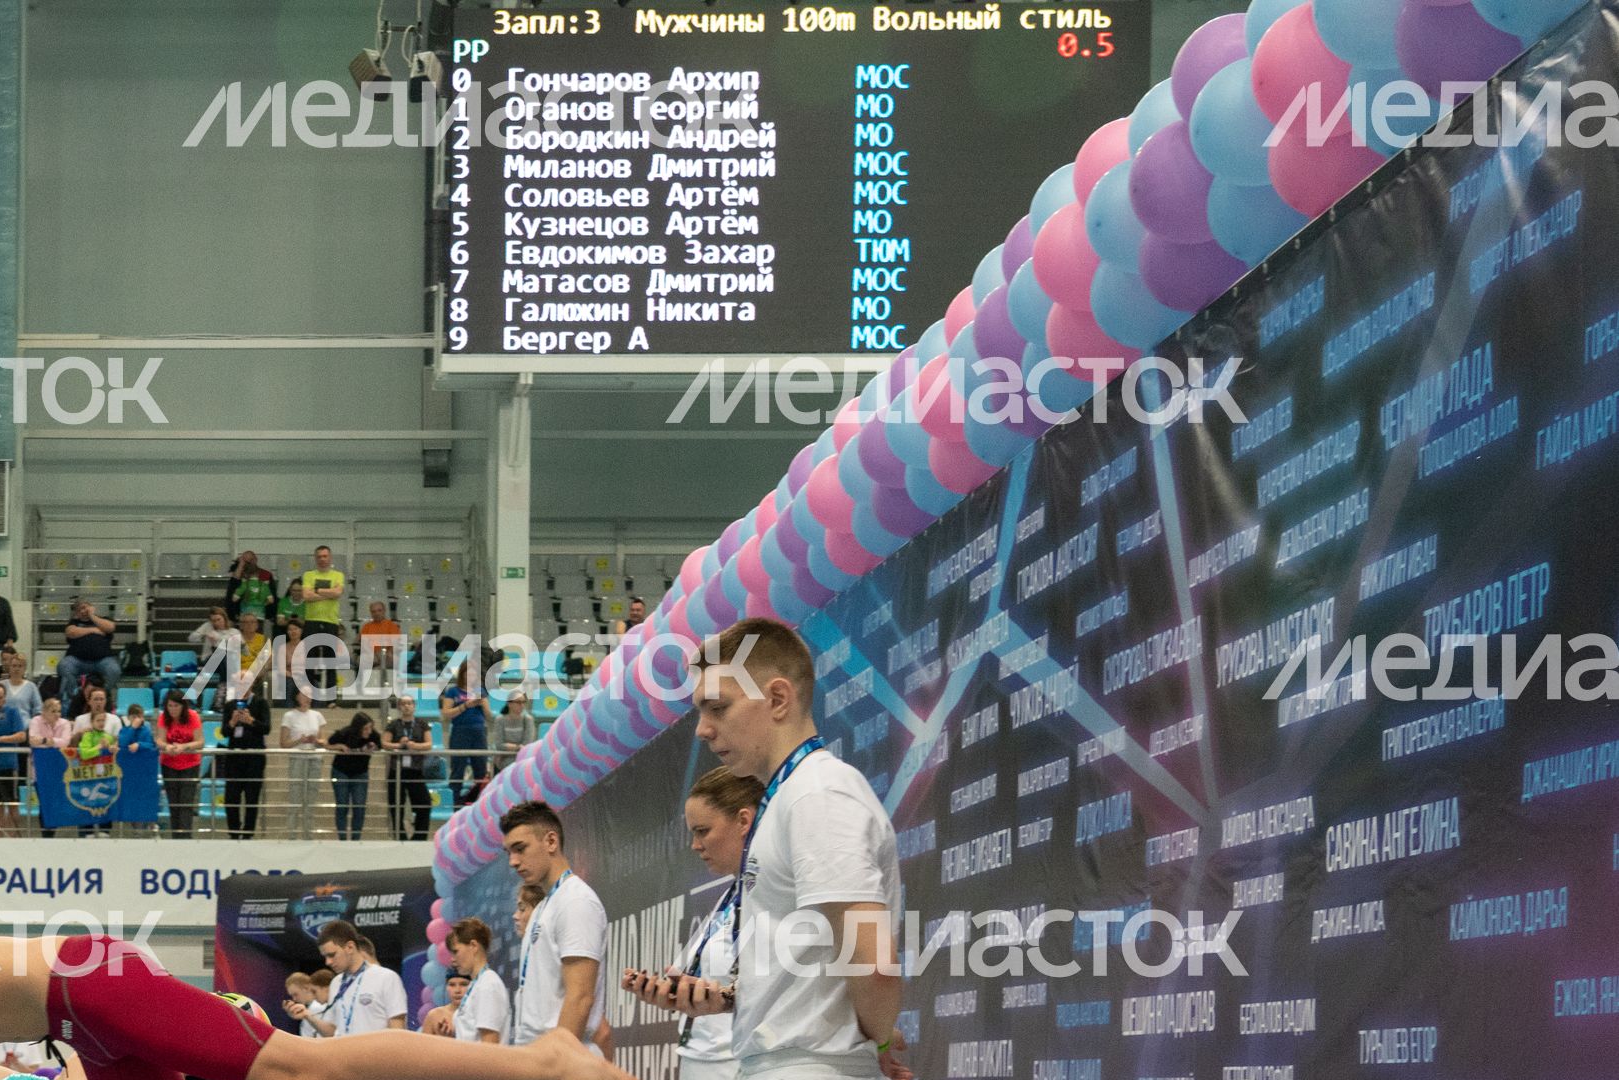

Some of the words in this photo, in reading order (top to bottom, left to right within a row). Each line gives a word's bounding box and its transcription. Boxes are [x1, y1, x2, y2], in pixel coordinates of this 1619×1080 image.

[493, 12, 601, 36] Запл:3
[634, 10, 765, 36] Мужчины
[782, 8, 856, 32] 100m
[872, 3, 1001, 32] Вольный
[1019, 8, 1112, 30] стиль
[1057, 33, 1115, 57] 0.5
[507, 68, 651, 96] Гончаров
[671, 68, 759, 96] Архип
[855, 65, 910, 90] МОС
[451, 98, 470, 121] 1
[506, 97, 622, 120] Оганов
[634, 91, 759, 125] Георгий
[855, 94, 894, 119] МО
[451, 126, 470, 149] 2
[506, 125, 649, 153] Бородкин
[668, 120, 776, 153] Андрей
[855, 122, 894, 147] МО
[451, 155, 469, 178] 3
[504, 154, 631, 177] Миланов
[648, 150, 776, 182] Дмитрий
[855, 151, 909, 176] МОС
[451, 184, 468, 207] 4
[505, 183, 649, 206] Соловьев
[667, 177, 759, 211] Артём
[853, 180, 908, 205] МОС
[451, 213, 468, 236] 5
[505, 212, 649, 240] Кузнецов
[666, 206, 759, 240] Артём
[853, 209, 893, 234] МО
[451, 241, 468, 264] 6
[505, 241, 667, 263] Евдокимов
[685, 240, 775, 268] Захар
[855, 237, 910, 262] ТЮМ
[451, 270, 468, 293] 7
[503, 269, 630, 292] Матасов
[646, 265, 774, 297] Дмитрий
[853, 266, 907, 291] МОС
[451, 299, 468, 322] 8
[505, 298, 629, 321] Галюжин
[646, 298, 756, 321] Никита
[852, 295, 890, 320] МО
[451, 328, 468, 351] 9
[503, 327, 611, 355] Бергер
[628, 327, 649, 350] А
[852, 324, 905, 349] МОС
[1448, 341, 1493, 416] ЛАДА
[1535, 406, 1579, 472] ГАЙДА
[1409, 533, 1438, 582] ИВАН
[1423, 576, 1504, 658] ТРУБАРОВ
[1507, 560, 1550, 632] ПЕТР
[1215, 625, 1264, 689] УРУСОВА
[1265, 597, 1335, 669] АНАСТАСИЯ
[1453, 696, 1506, 744] ВАЛЕРИЯ
[72, 766, 114, 779] МЕТОР
[1325, 815, 1382, 874] САВИНА
[1383, 797, 1461, 862] АНГЕЛИНА
[354, 910, 401, 927] CHALLENGE
[357, 895, 379, 910] MAD
[378, 893, 405, 908] WAVE
[1520, 886, 1568, 933] ДАРЬЯ
[1156, 990, 1216, 1036] ВЛАДИСЛАВ
[1554, 979, 1598, 1018] ЕЖОВА
[1358, 1027, 1408, 1065] ТУРЫШЕВ
[1409, 1026, 1437, 1063] ЕГОР
